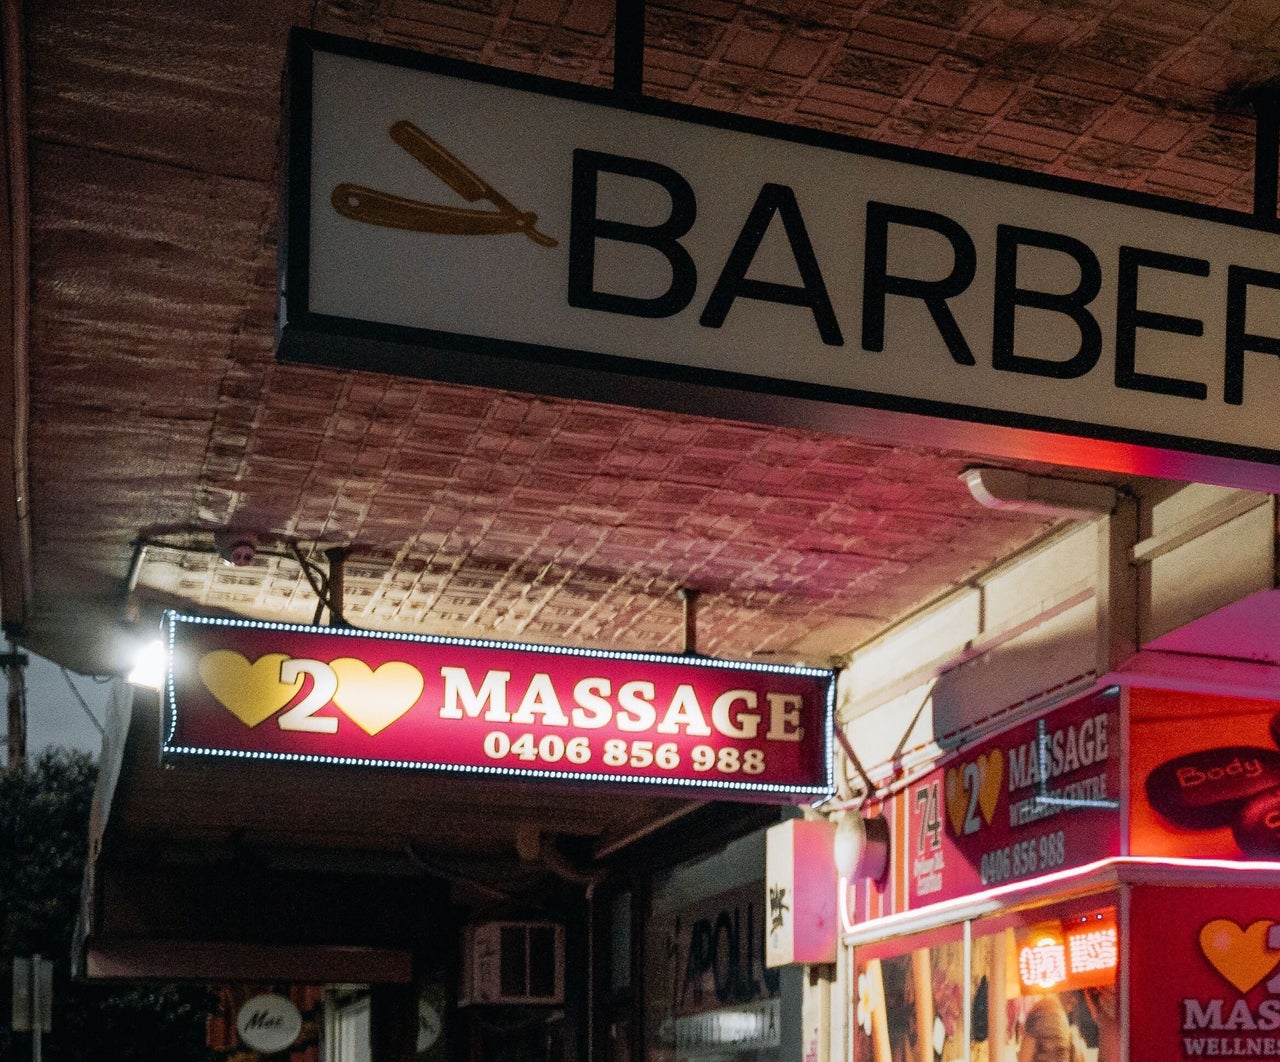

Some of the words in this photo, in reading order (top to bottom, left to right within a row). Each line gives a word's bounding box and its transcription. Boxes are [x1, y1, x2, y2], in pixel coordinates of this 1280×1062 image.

[278, 658, 340, 734] 2
[440, 667, 806, 742] MASSAGE
[484, 731, 592, 764] 0406
[603, 739, 680, 770] 856
[692, 746, 766, 775] 988
[963, 764, 981, 836] 2
[1008, 712, 1109, 793] MASSAGE
[1175, 756, 1265, 789] Body
[916, 780, 942, 854] 74
[1013, 838, 1037, 877] 856
[1040, 830, 1065, 869] 988
